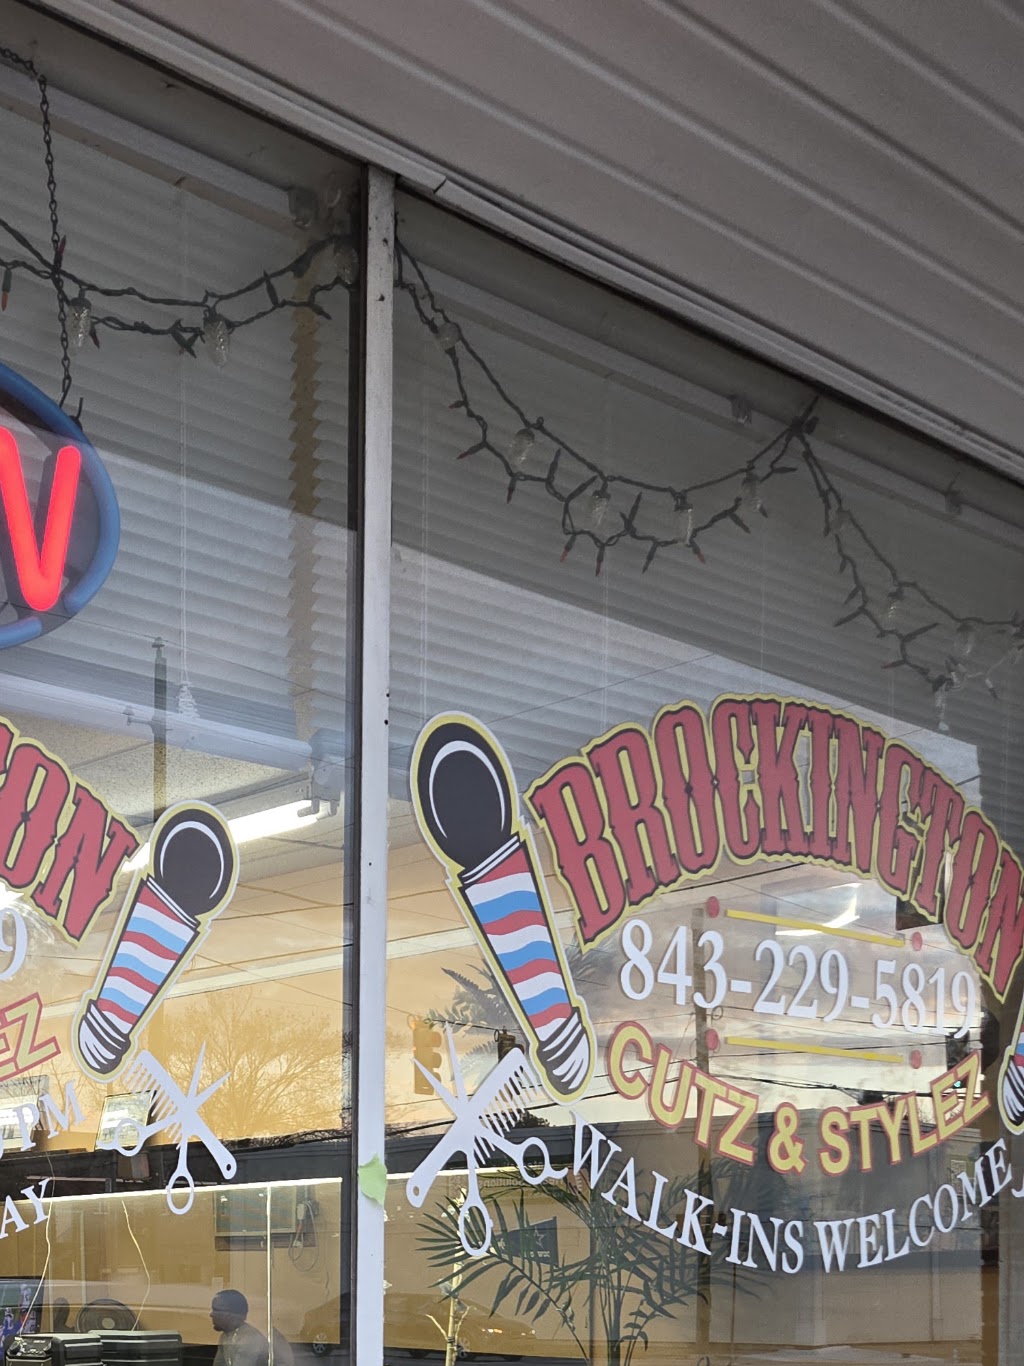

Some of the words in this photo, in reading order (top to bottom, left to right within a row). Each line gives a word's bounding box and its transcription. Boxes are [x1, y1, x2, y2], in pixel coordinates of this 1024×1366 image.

[619, 919, 977, 1040] 843-229-5819
[12, 1079, 87, 1152] PM
[605, 1020, 760, 1167] CUTZ
[767, 1101, 808, 1177] &
[817, 1050, 993, 1178] STYLEZ
[568, 1109, 805, 1275] WALK-INS
[813, 1137, 1013, 1276] WELCOME
